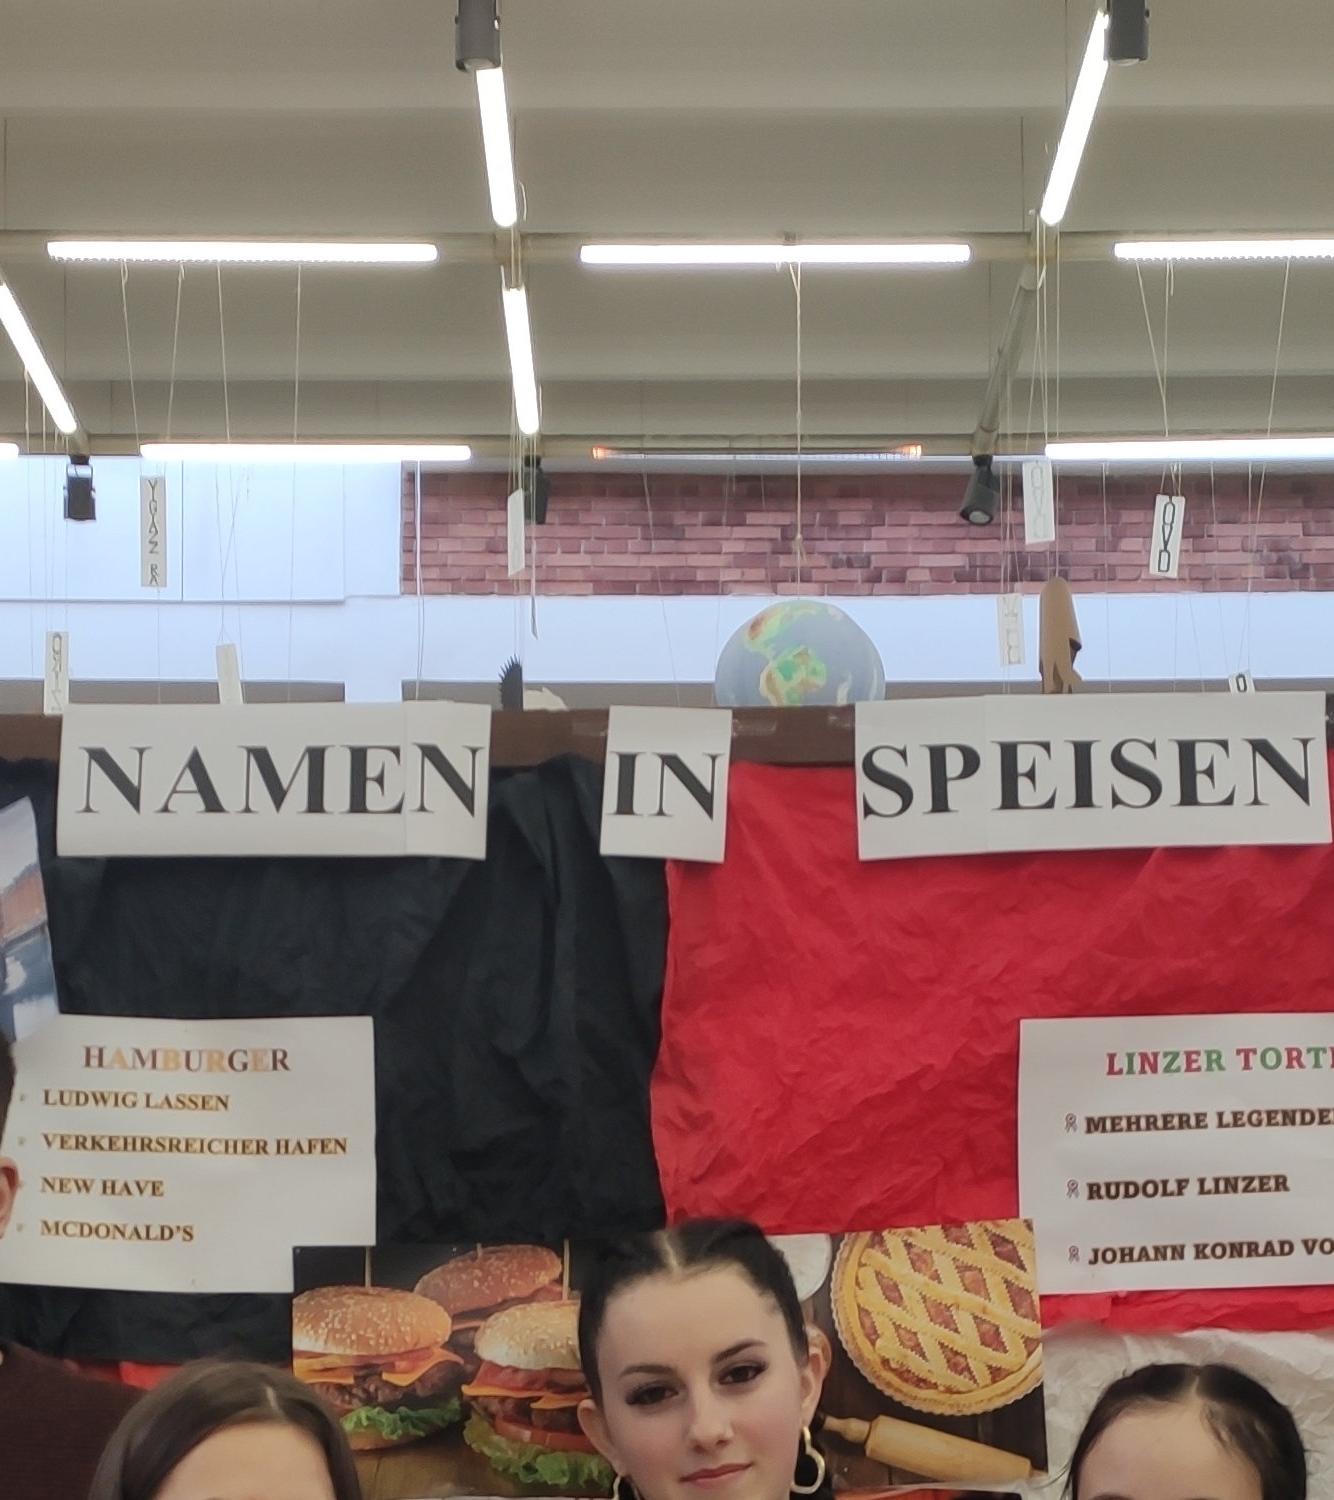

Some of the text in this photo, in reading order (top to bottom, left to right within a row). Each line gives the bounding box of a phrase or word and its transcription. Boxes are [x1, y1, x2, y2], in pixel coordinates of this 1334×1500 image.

[75, 736, 1317, 819] NAMEN IN SPEISEN
[82, 1045, 291, 1073] HAMBURGER
[1107, 1051, 1225, 1076] LINZER
[42, 1090, 230, 1111] LUDWIG LASSEN
[1084, 1111, 1210, 1135] MEHRERE
[42, 1133, 348, 1155] VERKEHRSREICHER HAFEN
[41, 1177, 164, 1198] NEW HAVE
[1087, 1174, 1290, 1200] RUDOLF LINZER
[1087, 1243, 1185, 1266] JOHANN
[1194, 1239, 1295, 1260] KONRAD
